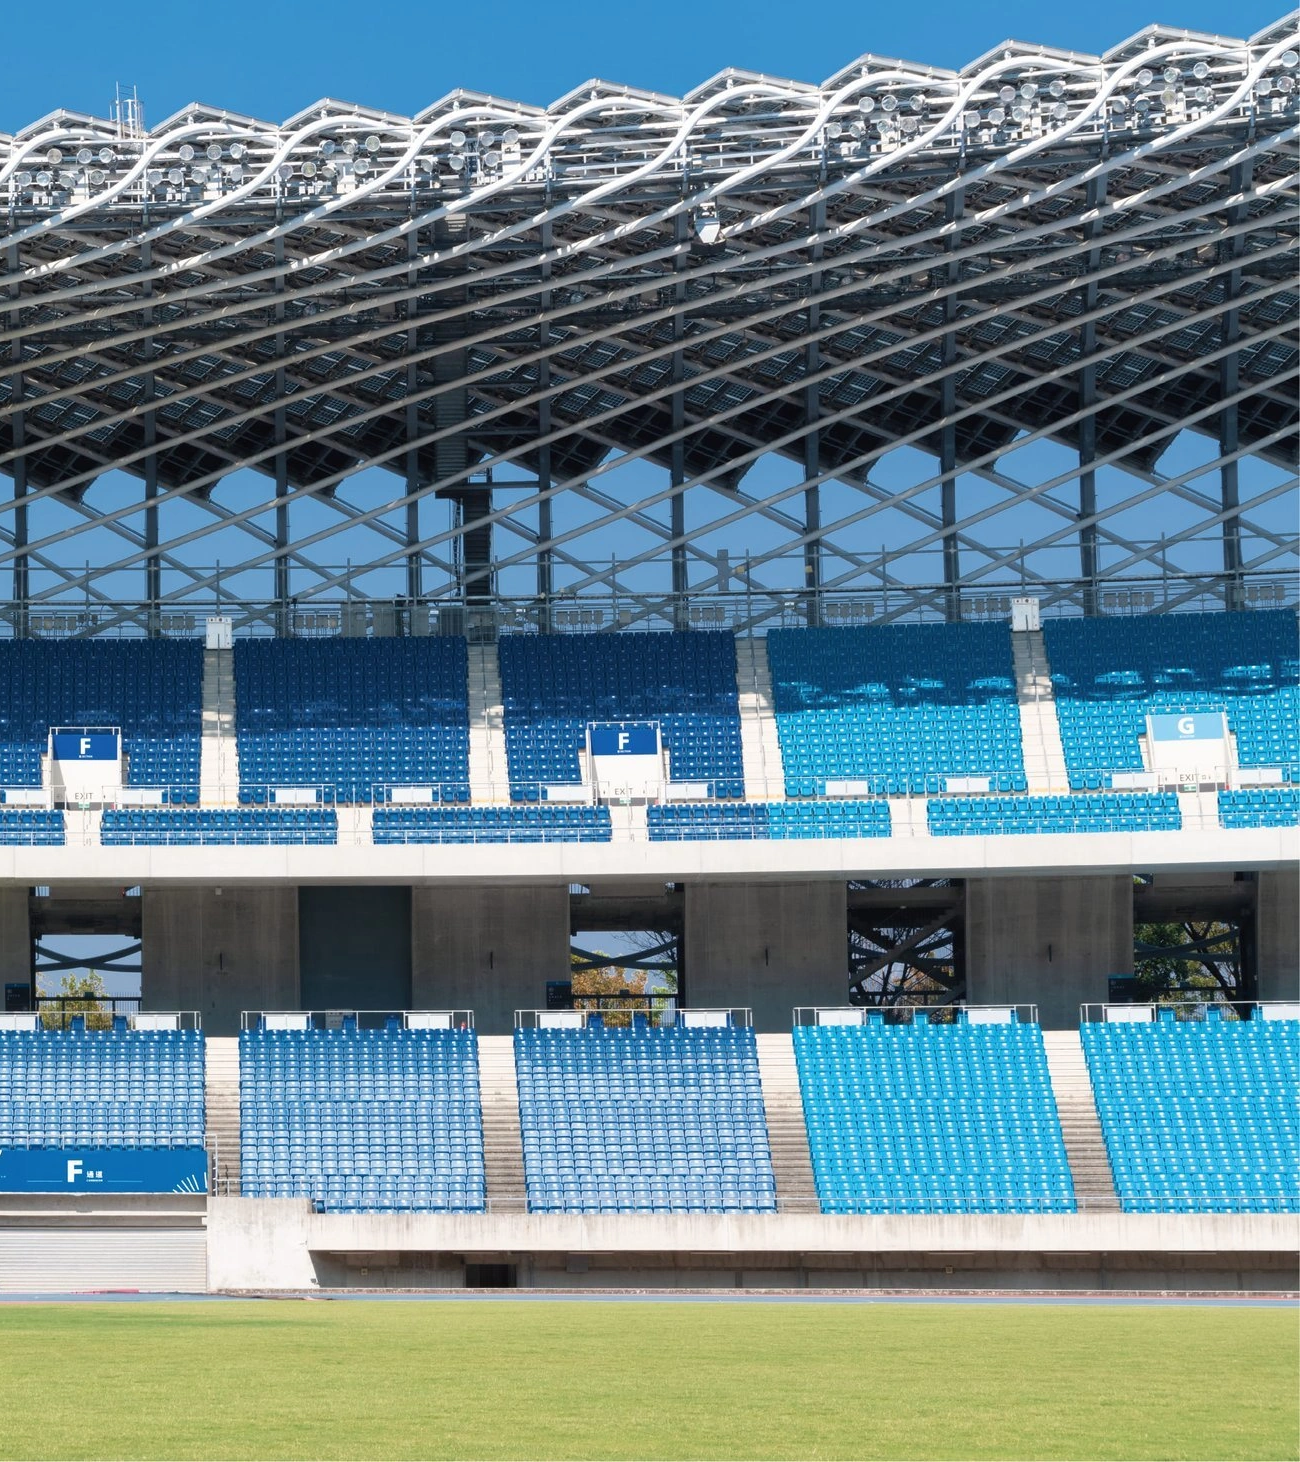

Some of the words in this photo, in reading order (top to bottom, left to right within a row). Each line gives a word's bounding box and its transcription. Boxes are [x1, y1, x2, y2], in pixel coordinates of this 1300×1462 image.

[1178, 717, 1195, 735] G
[80, 738, 91, 755] F
[618, 732, 630, 750] F
[67, 1160, 83, 1183] F
